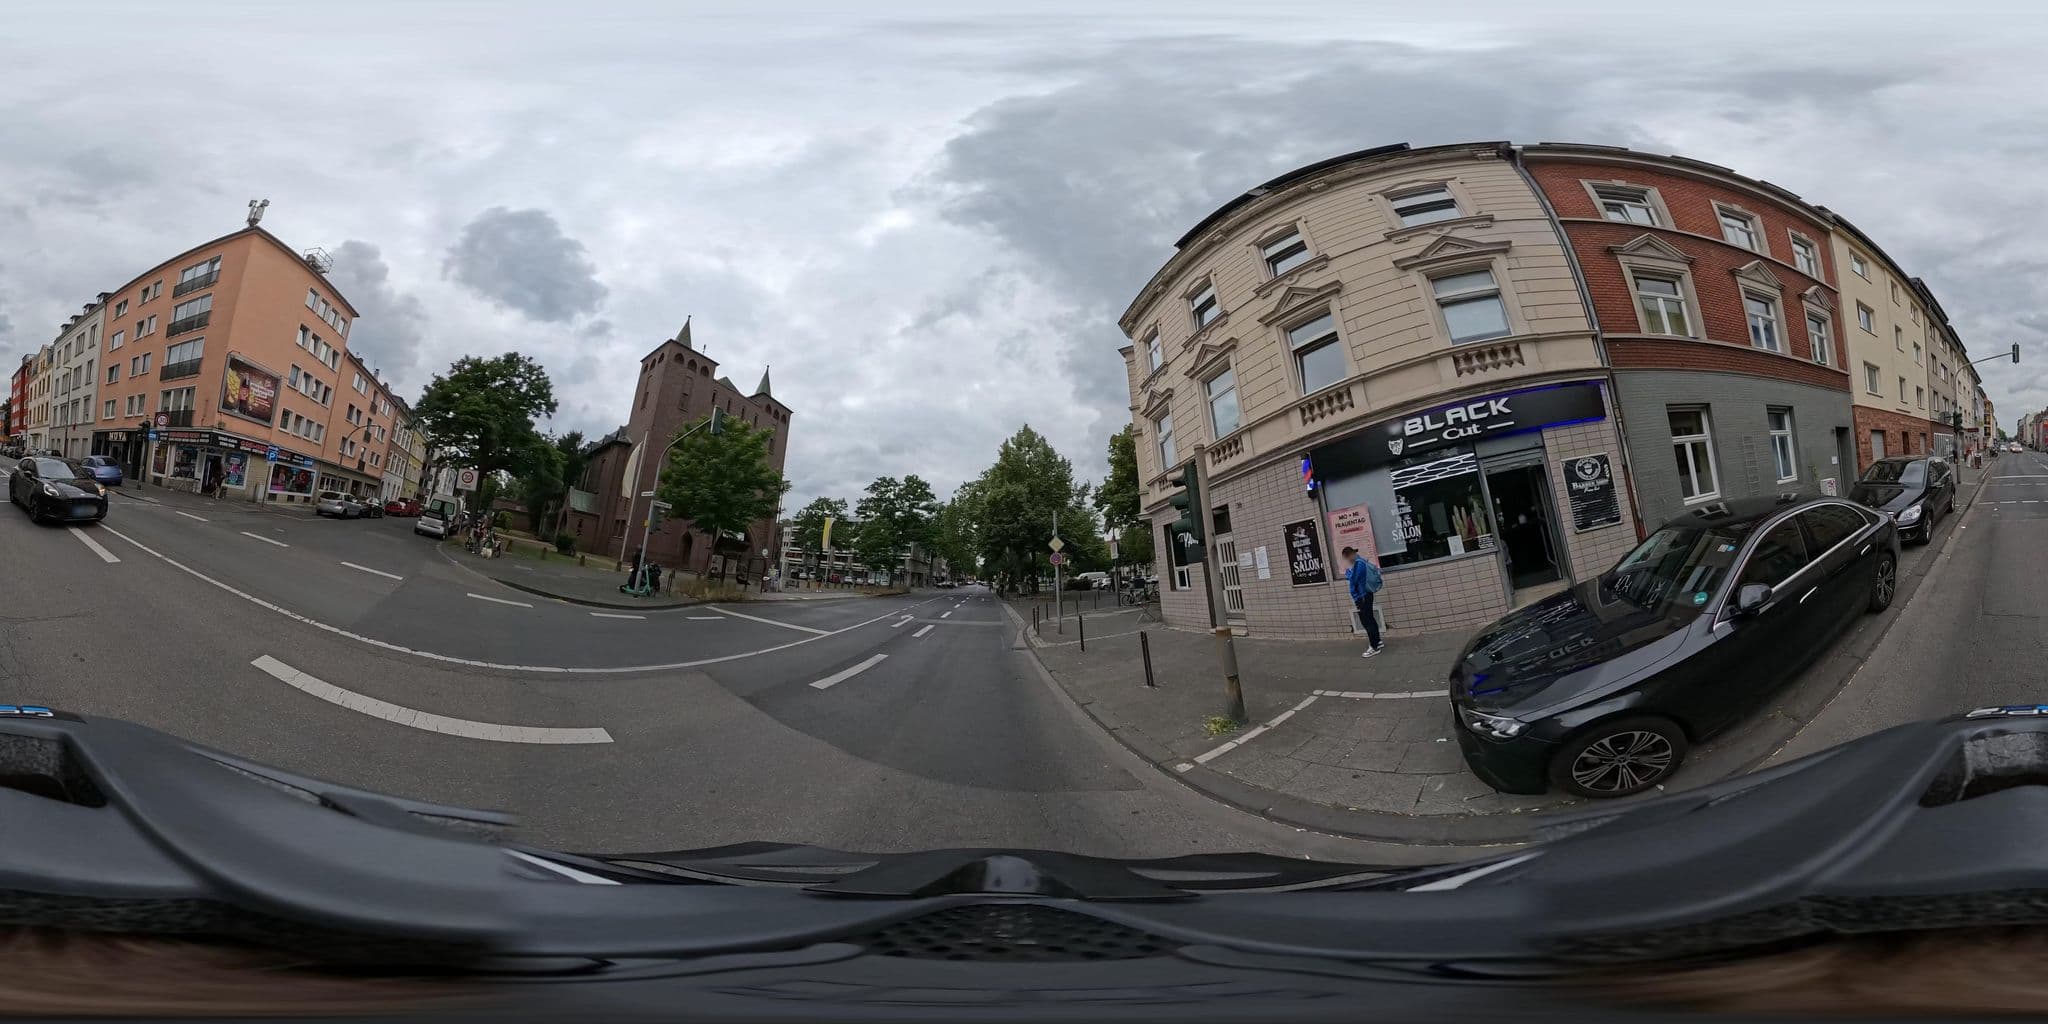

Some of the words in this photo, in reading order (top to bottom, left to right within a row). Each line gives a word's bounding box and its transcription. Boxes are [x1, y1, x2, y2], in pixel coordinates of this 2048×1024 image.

[1404, 397, 1512, 436] BLACK
[1442, 423, 1482, 440] Cut
[1391, 524, 1422, 541] SALON
[1293, 558, 1320, 573] SALON
